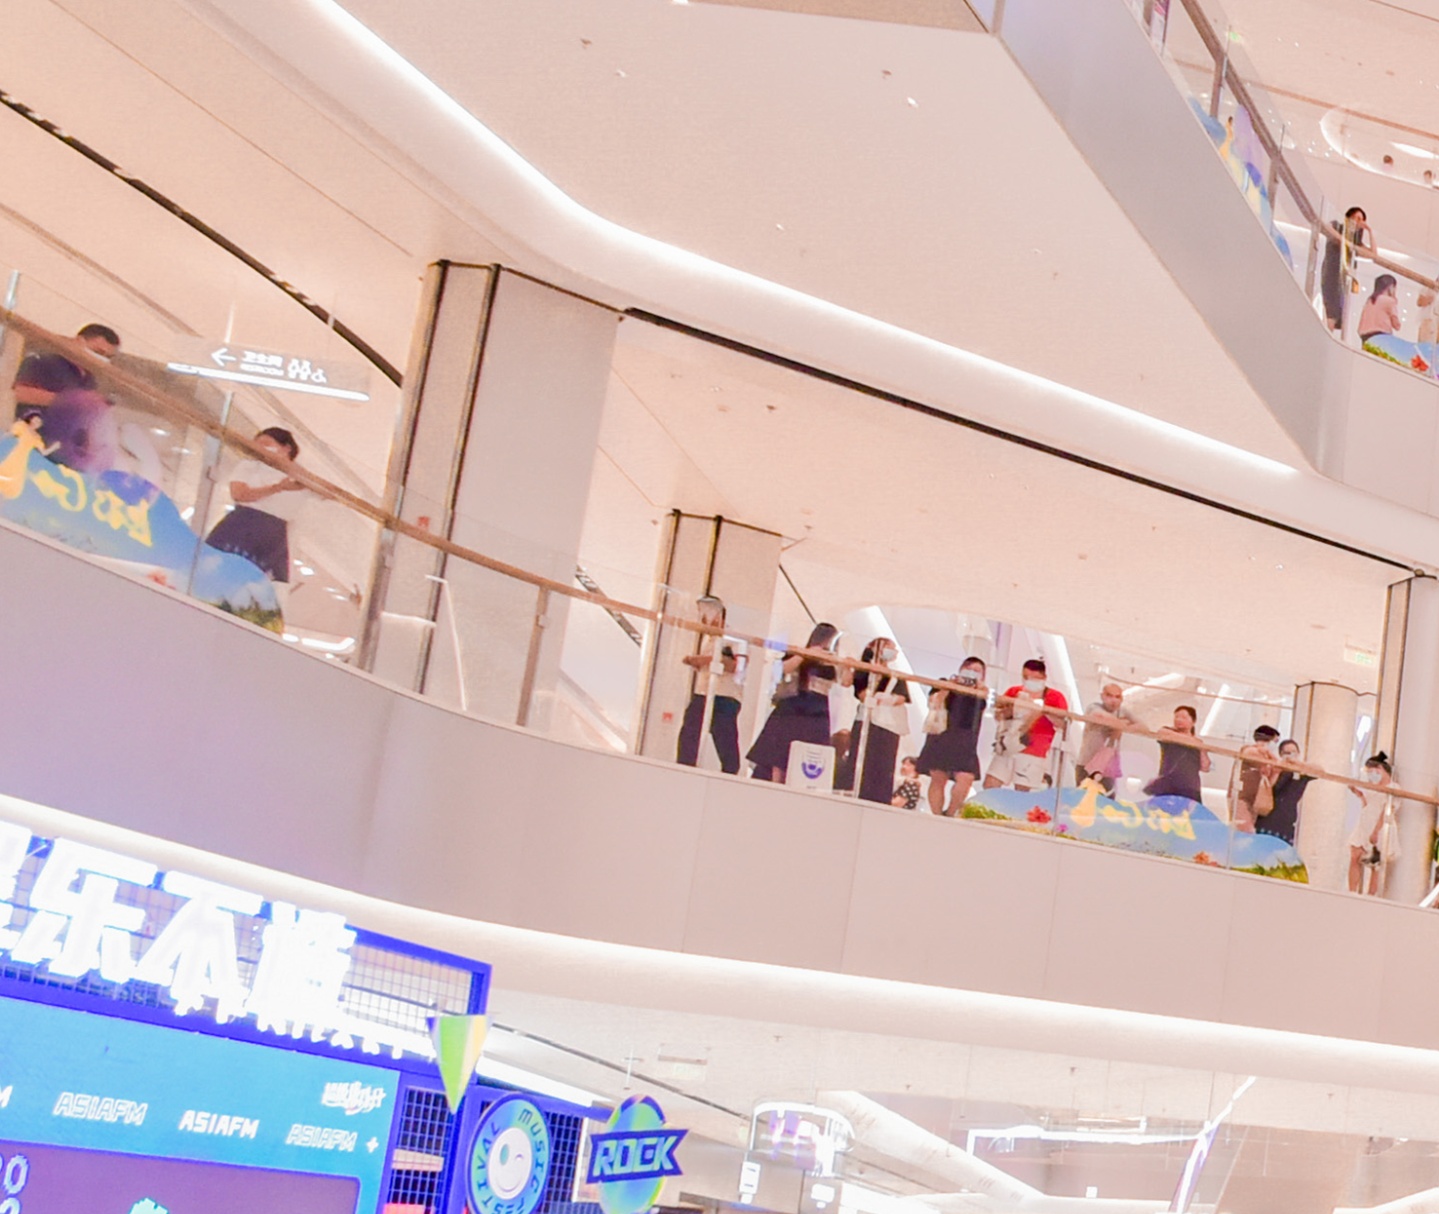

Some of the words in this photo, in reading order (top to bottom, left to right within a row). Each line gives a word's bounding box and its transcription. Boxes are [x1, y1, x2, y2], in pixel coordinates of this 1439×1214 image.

[53, 1091, 147, 1126] ASIAFM
[178, 1109, 259, 1139] ASIAFM
[593, 1136, 677, 1177] ROCK
